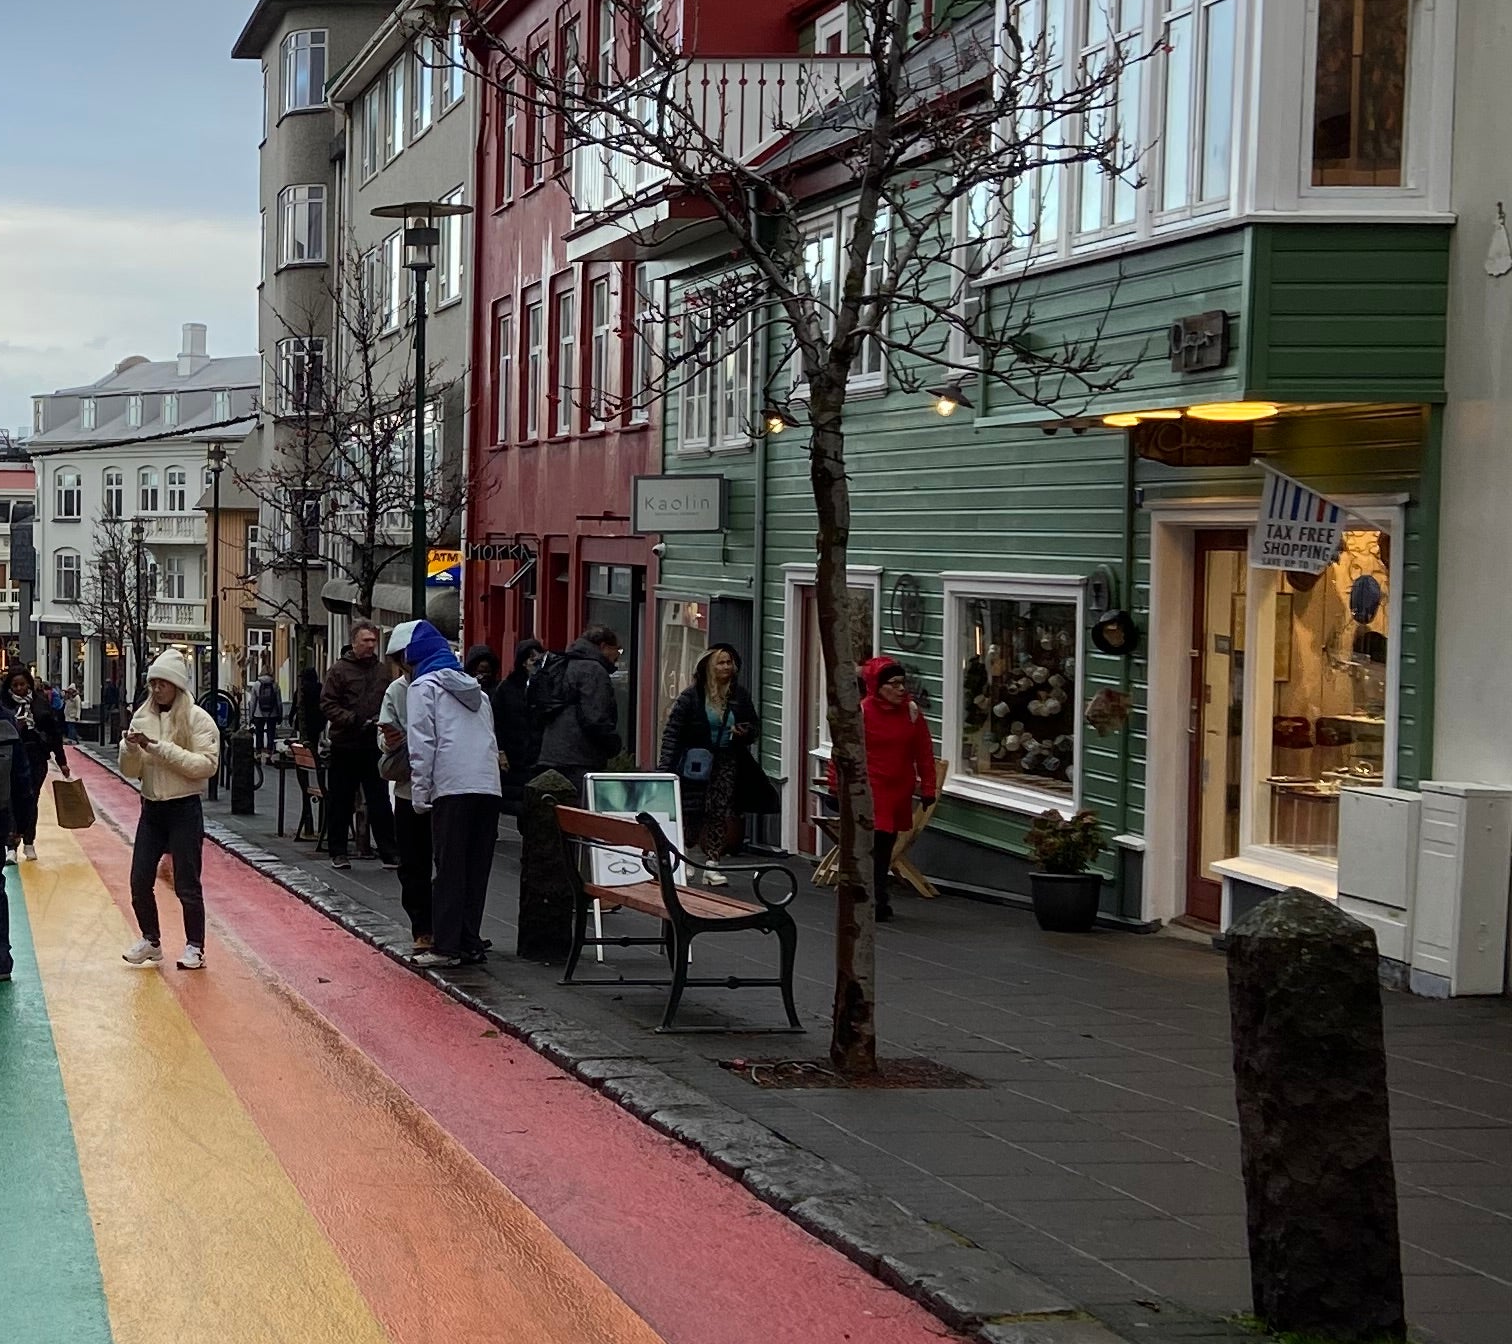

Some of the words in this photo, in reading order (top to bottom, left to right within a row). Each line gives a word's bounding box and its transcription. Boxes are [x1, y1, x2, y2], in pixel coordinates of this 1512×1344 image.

[644, 495, 710, 511] Kaolin
[1266, 523, 1294, 541] TAX
[1298, 526, 1336, 545] FREE
[433, 552, 459, 563] ATM
[466, 543, 531, 561] MOKKA
[1262, 540, 1331, 562] SHOPPING
